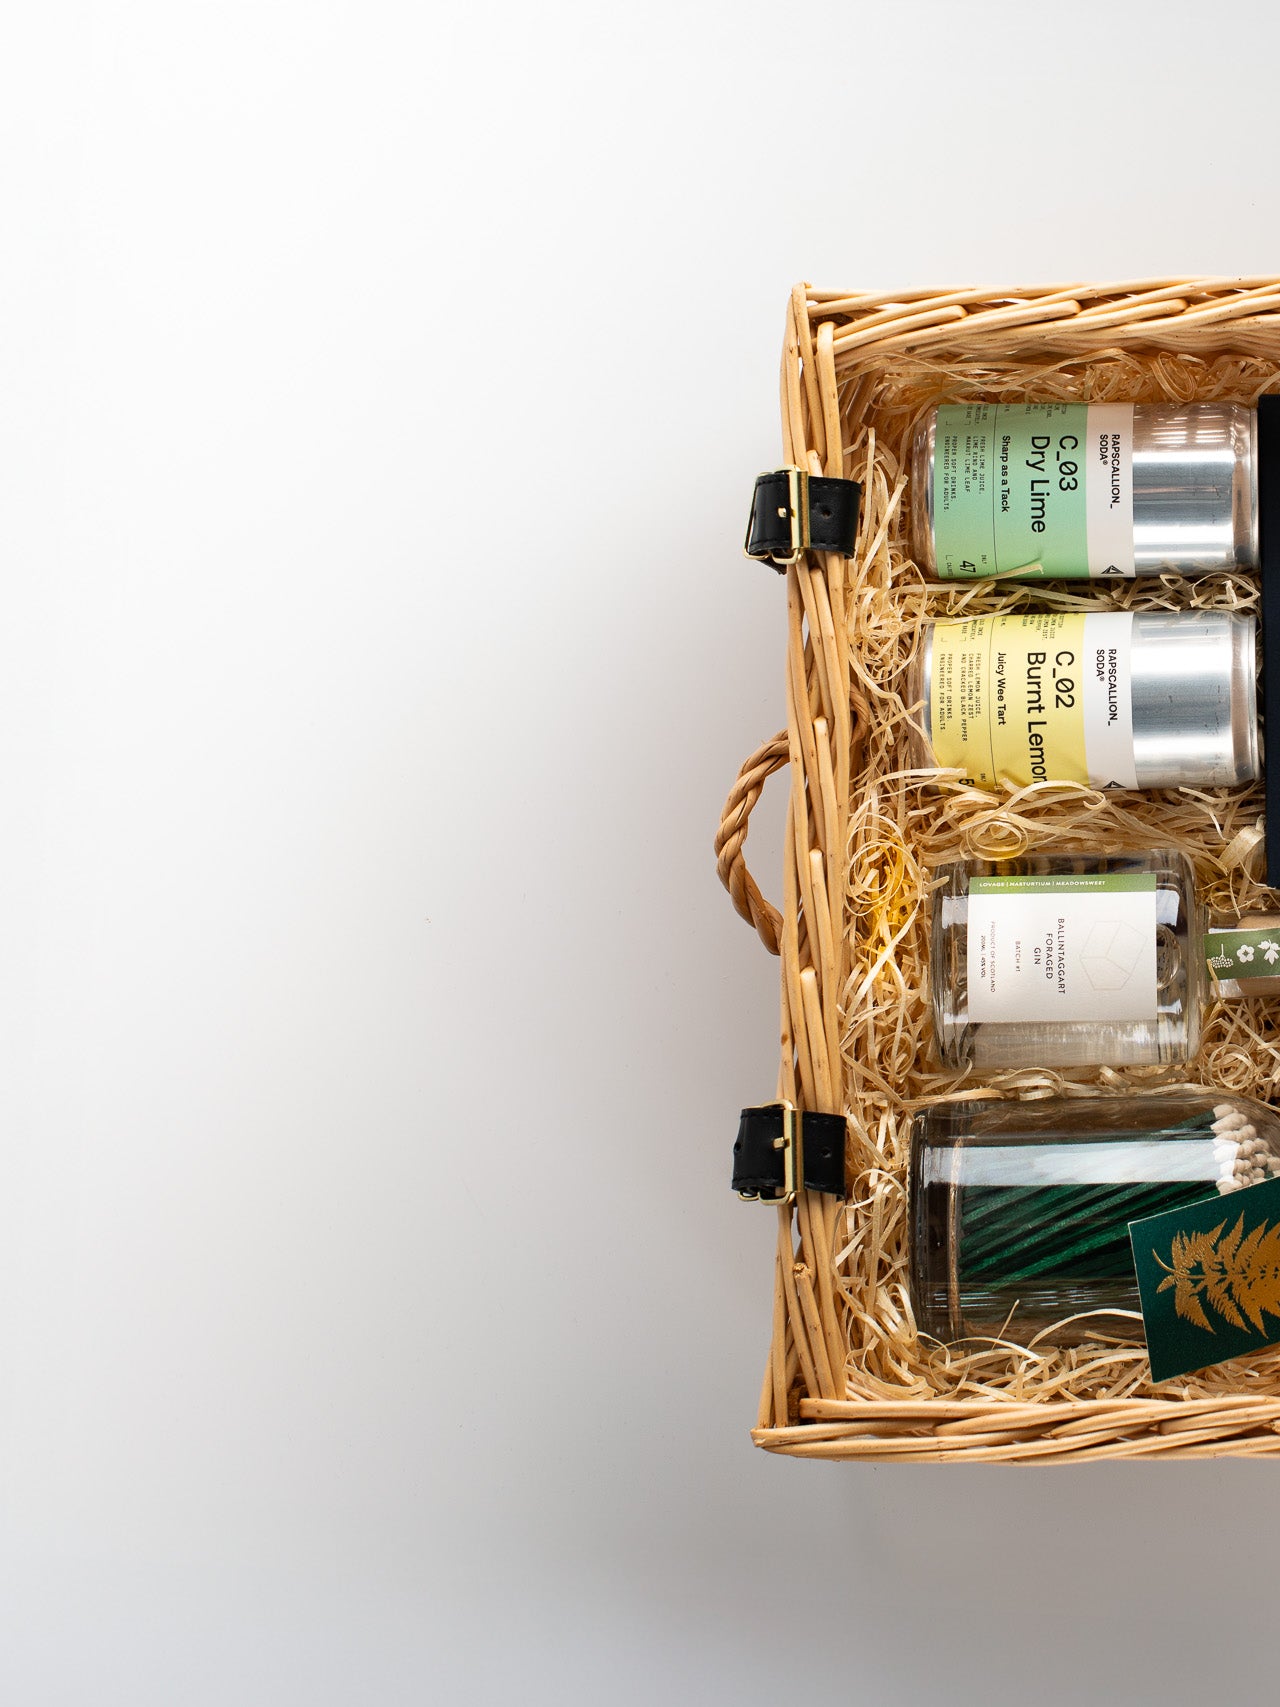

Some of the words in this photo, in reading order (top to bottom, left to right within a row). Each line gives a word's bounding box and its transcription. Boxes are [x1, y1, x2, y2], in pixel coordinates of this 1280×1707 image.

[1000, 436, 1010, 462] Sharp
[1026, 436, 1050, 471] Dry
[1001, 465, 1008, 476] as
[1057, 435, 1078, 491] C_03
[1031, 479, 1050, 533] Lime
[960, 561, 976, 572] 47
[996, 652, 1006, 675] Juicy
[997, 679, 1006, 701] Wee
[1027, 652, 1046, 714] Burnt
[1053, 651, 1075, 708] C_02
[998, 704, 1006, 725] Tart
[959, 779, 975, 787] 5
[1033, 947, 1041, 965] GIN
[1057, 918, 1065, 994] BALLINTAGGART
